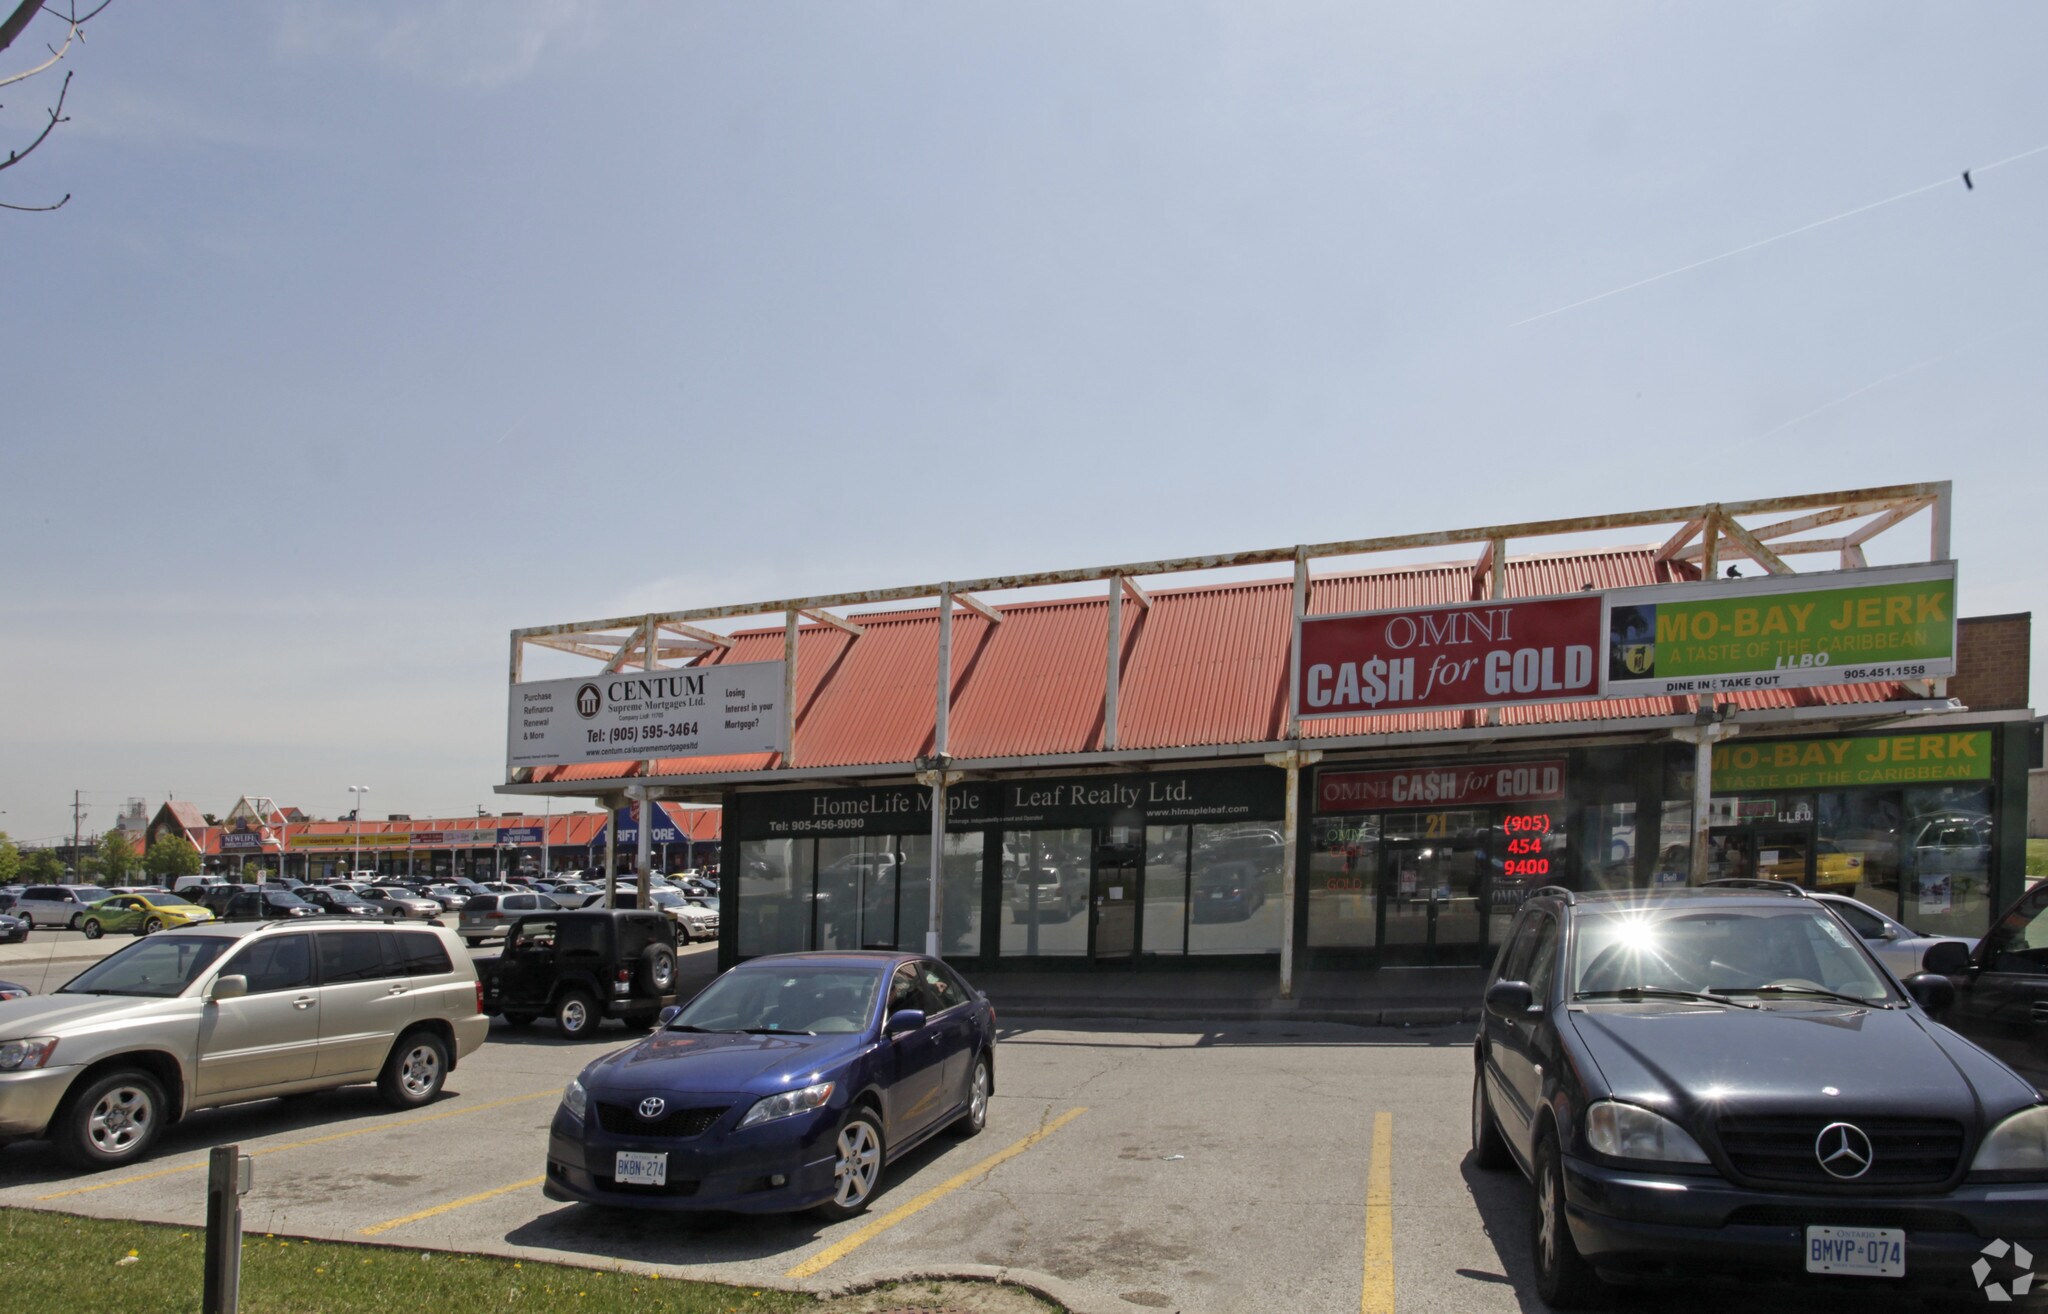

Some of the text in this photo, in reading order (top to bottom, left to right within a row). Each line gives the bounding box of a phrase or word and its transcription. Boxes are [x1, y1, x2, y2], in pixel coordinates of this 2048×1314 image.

[1656, 592, 1946, 643] MO-BAY JERK
[1385, 608, 1513, 649] OMNI
[1670, 631, 1928, 663] A TASTE OF THE CARIBBEAN
[1775, 652, 1829, 670] LLBO
[1307, 645, 1592, 708] CA$H for GOLD
[1844, 665, 1925, 679] 905.451.1558
[608, 674, 705, 702] CENTUM
[1666, 681, 1694, 692] DINE
[1698, 680, 1711, 690] IN
[1720, 677, 1751, 688] TAKE
[1754, 676, 1780, 686] OUT
[524, 693, 552, 702] Purchase
[726, 688, 745, 698] Losing
[524, 705, 553, 714] Refinance
[608, 697, 706, 714] Supreme Mortgages Ltd.
[725, 703, 773, 713] Interest in your
[524, 718, 549, 727] Renewal
[725, 718, 759, 730] Mortgage?
[530, 731, 544, 739] More
[587, 722, 698, 744] Tel: (905) 595-3464
[1711, 734, 1977, 770] MO-BAY JERK
[1727, 775, 1783, 788] TASTE
[1786, 773, 1809, 785] OF
[1818, 771, 1850, 783] THE
[1858, 765, 1972, 782] CARIBBEAN
[1324, 767, 1559, 803] OMNI CA$H for GOLD
[813, 780, 1193, 815] HomeLife Mple Leaf Realty Ltd.
[1146, 805, 1248, 817] www.hlmapleleaf.com
[769, 818, 864, 831] Tel: 905-456-9090
[1425, 814, 1447, 838] 21
[1504, 814, 1550, 835] (905)
[603, 829, 637, 842] TRIFT
[1508, 838, 1541, 854] 454
[1504, 858, 1549, 875] 9400
[1327, 878, 1362, 890] GOLD
[1663, 873, 1677, 881] Bell
[1492, 890, 1525, 904] OMNI
